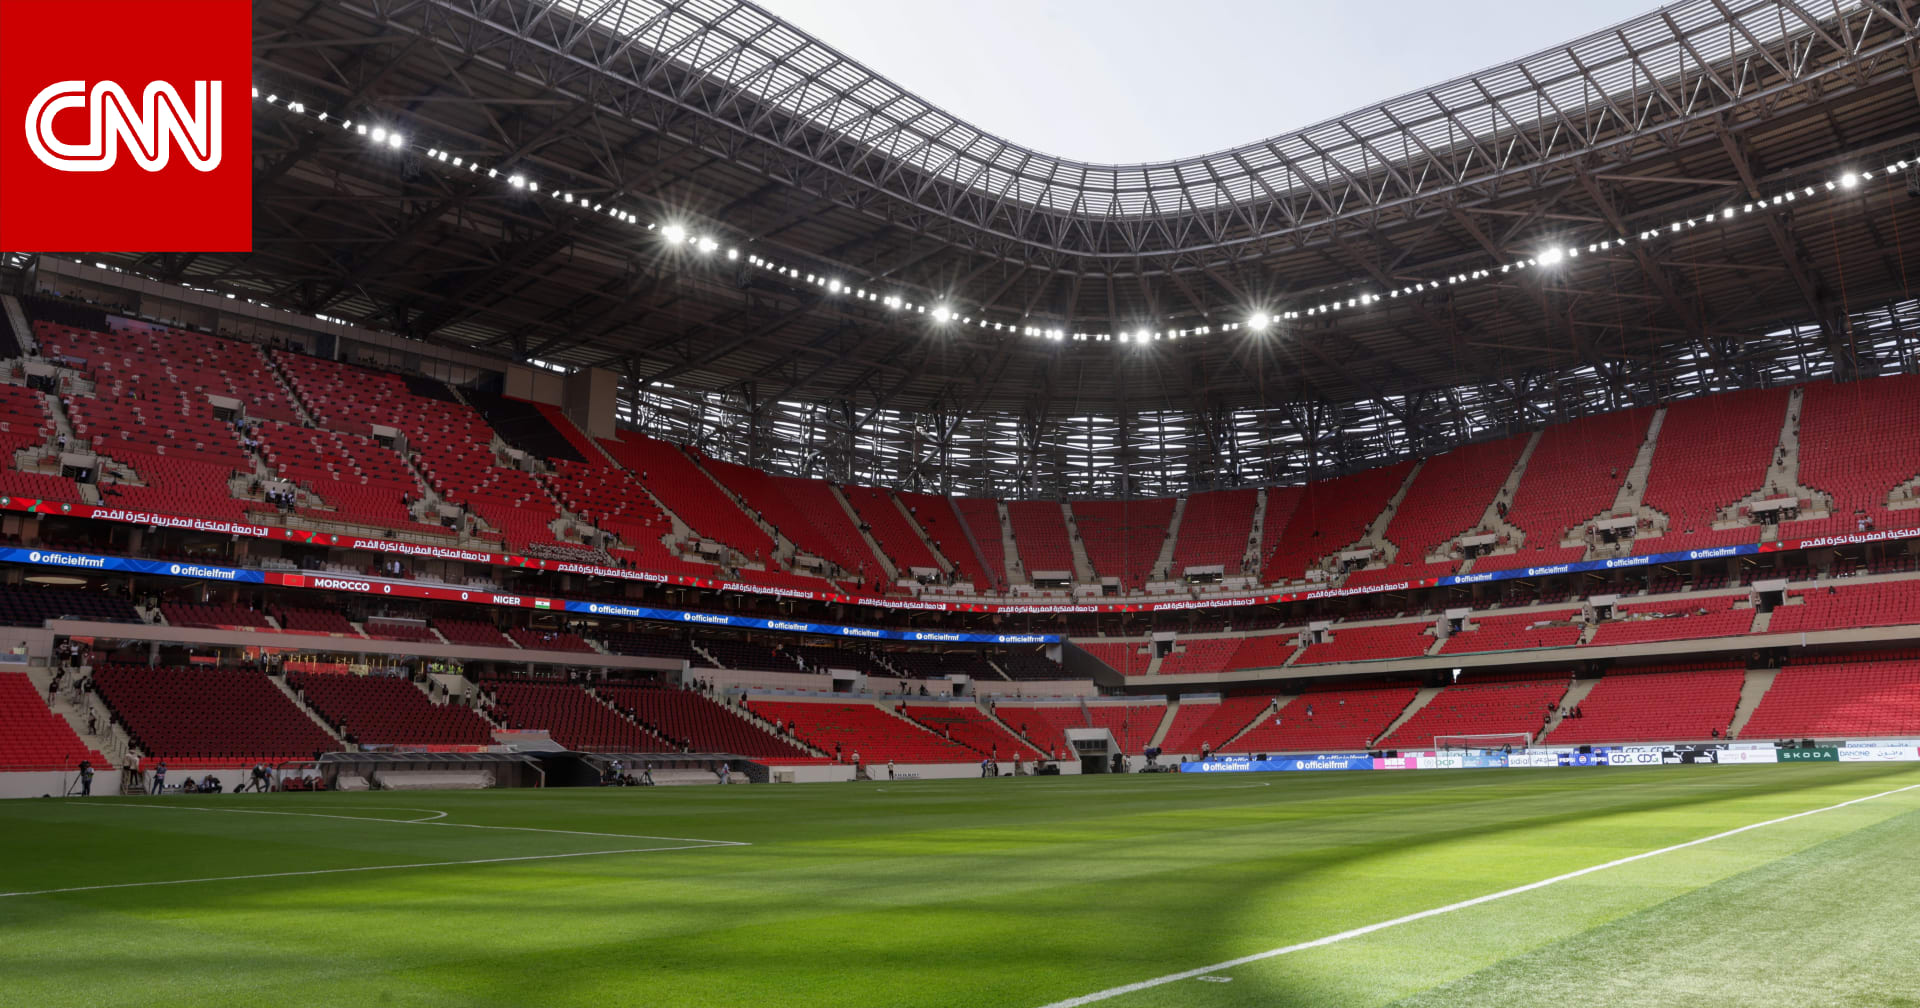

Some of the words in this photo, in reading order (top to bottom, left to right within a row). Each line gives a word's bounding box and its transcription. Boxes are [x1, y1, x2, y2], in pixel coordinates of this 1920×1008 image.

[91, 510, 124, 519] القدم
[126, 512, 150, 523] لكرة
[151, 514, 193, 527] المغربية
[194, 519, 230, 531] الملكية
[1827, 536, 1847, 545] لكرة
[1849, 532, 1886, 543] المغربية
[354, 540, 378, 549] القدم
[380, 542, 398, 551] لكرة
[399, 543, 431, 554] المغربية
[1800, 539, 1826, 549] القدم
[432, 547, 460, 558] الملكية
[1698, 547, 1736, 558] officielfrmf
[42, 553, 104, 567] officielfrmf
[181, 567, 235, 579] officielfrmf
[314, 578, 370, 592] MOROCCO
[383, 585, 391, 593] 0
[461, 592, 468, 600] 0
[493, 595, 521, 606] NIGER
[598, 605, 639, 616] officielfrmf
[691, 615, 728, 624] officielfrmf
[923, 633, 959, 641] officielfrmf
[1210, 762, 1249, 771] officielfrmf
[1304, 760, 1348, 769] officielfrmf
